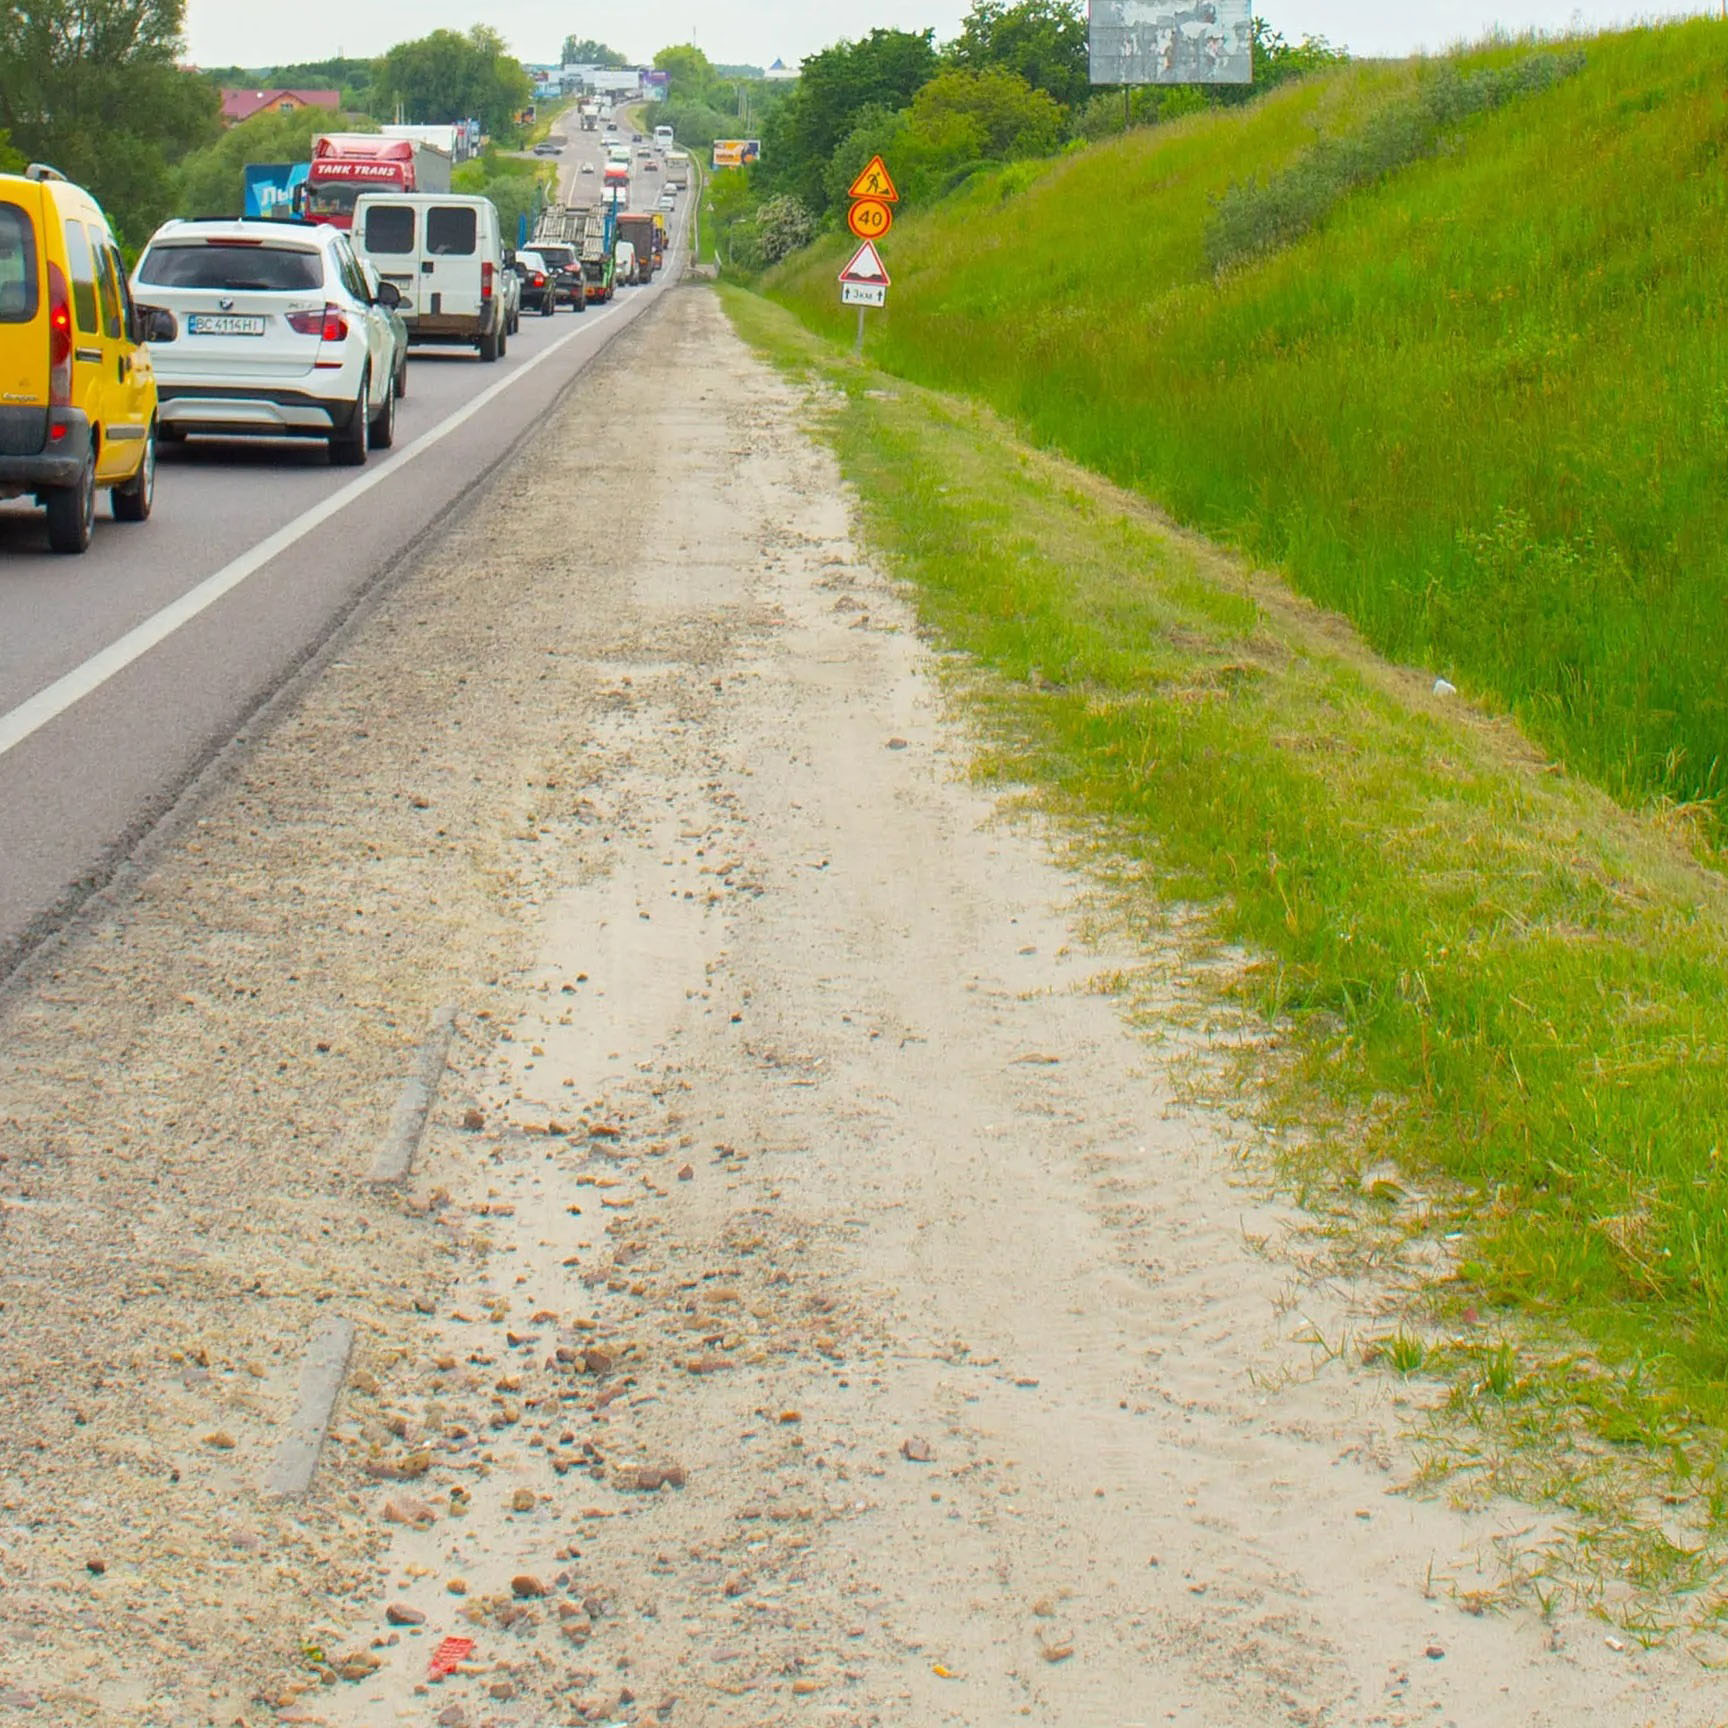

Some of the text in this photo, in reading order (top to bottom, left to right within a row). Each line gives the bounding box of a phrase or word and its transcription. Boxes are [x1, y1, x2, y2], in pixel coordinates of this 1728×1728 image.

[318, 164, 396, 177] TANK TRANS
[858, 210, 883, 227] 40
[196, 318, 215, 331] BC
[215, 318, 241, 331] 4114
